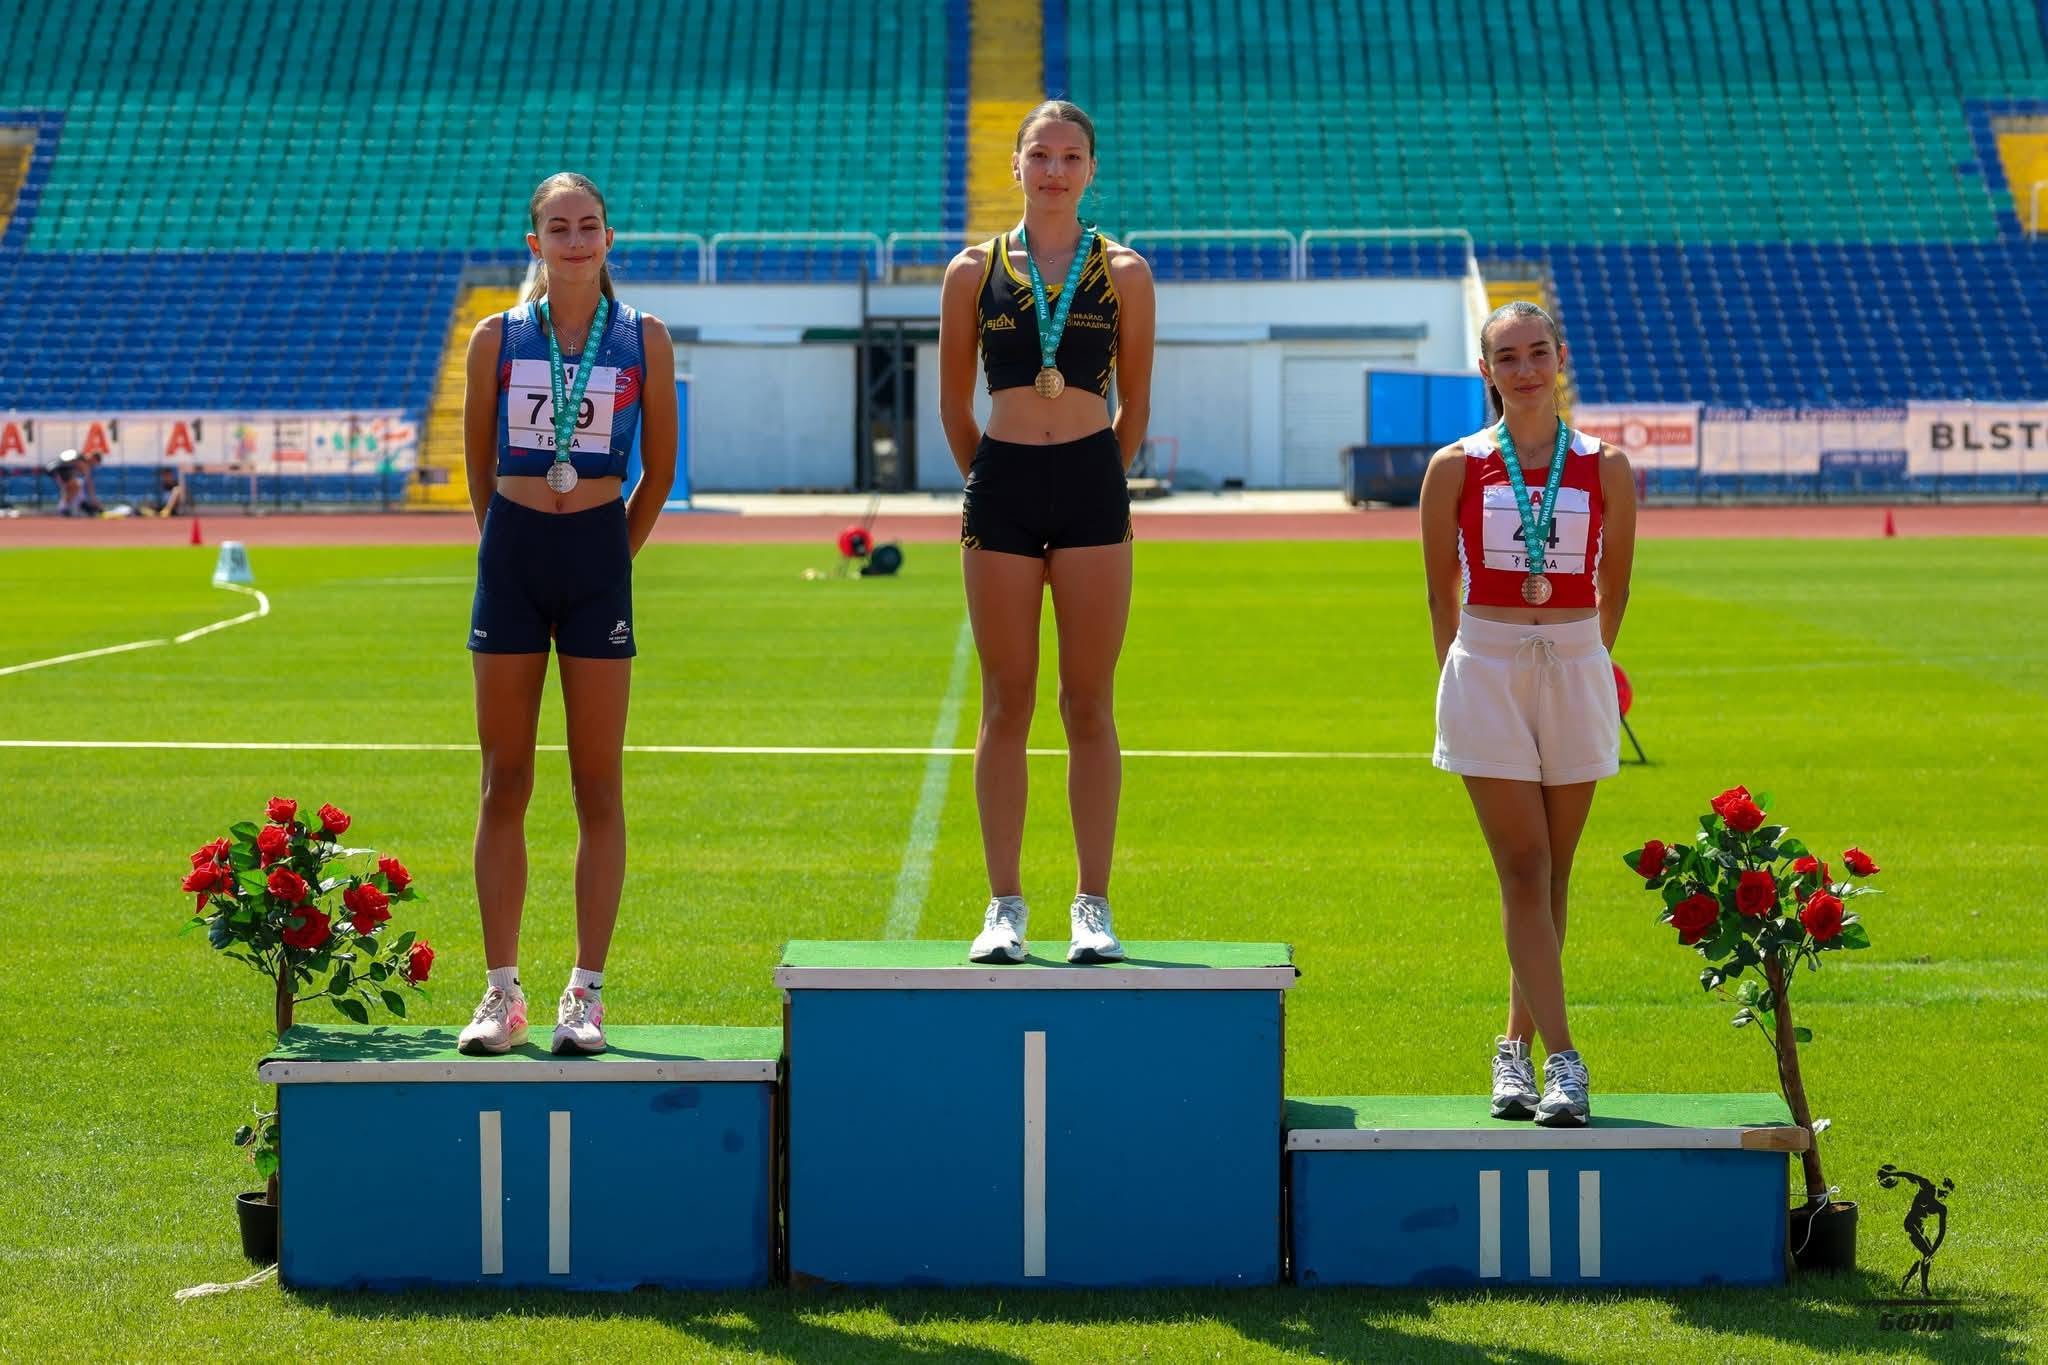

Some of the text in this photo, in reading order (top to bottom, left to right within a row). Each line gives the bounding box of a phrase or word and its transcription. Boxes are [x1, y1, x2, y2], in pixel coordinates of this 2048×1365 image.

[1035, 284, 1047, 320] АТЛЕТИКА
[553, 351, 561, 371] ЛЕКА
[554, 374, 564, 413] АТЛЕТИКА
[527, 393, 595, 429] 79
[547, 436, 580, 449] БА
[1931, 422, 2048, 450] BLST
[1549, 472, 1559, 488] ЛЕКА
[1540, 490, 1554, 526] АТЛЕТИКА
[1524, 558, 1557, 569] БЛА
